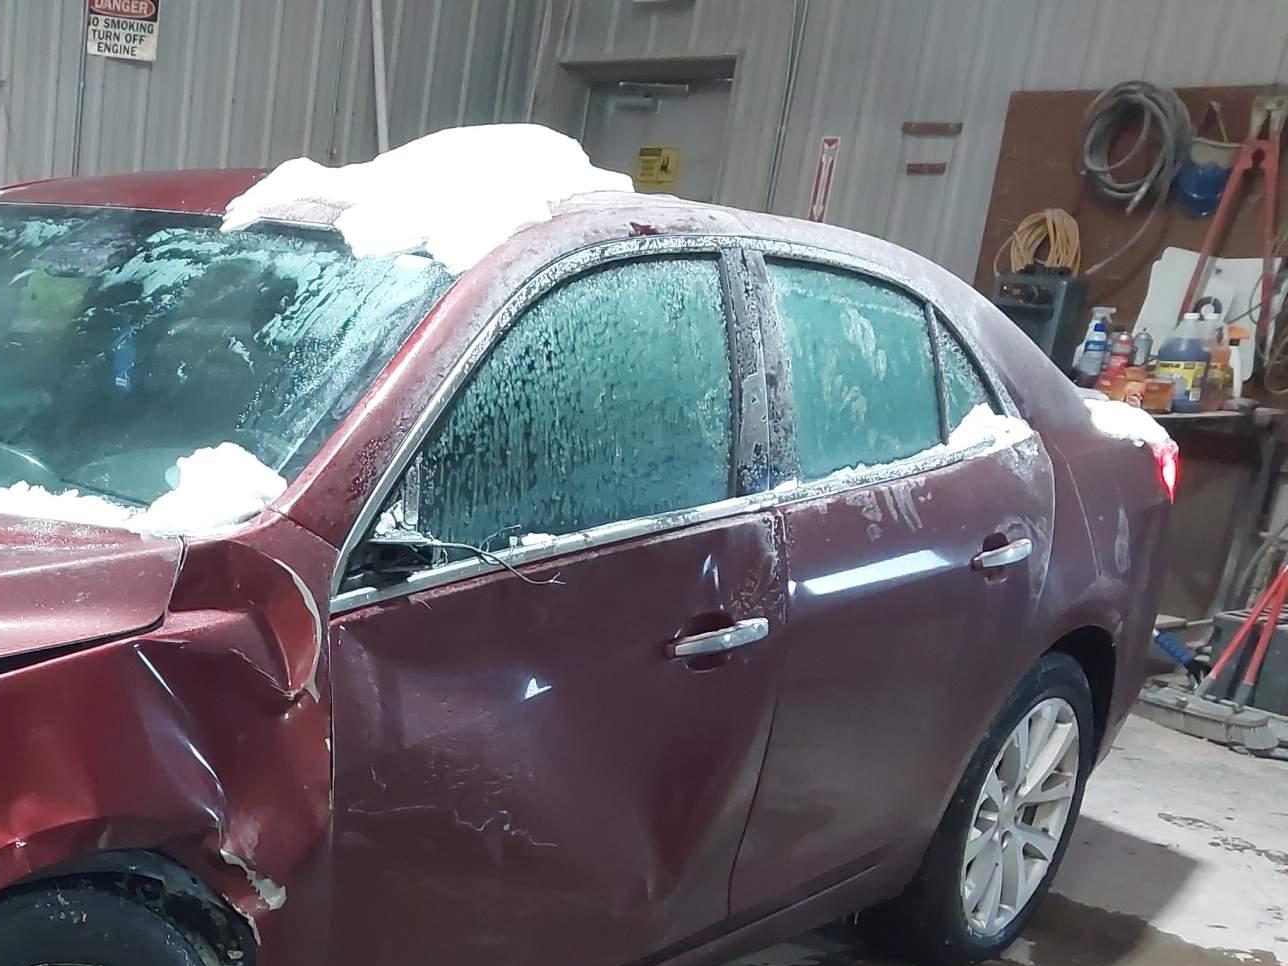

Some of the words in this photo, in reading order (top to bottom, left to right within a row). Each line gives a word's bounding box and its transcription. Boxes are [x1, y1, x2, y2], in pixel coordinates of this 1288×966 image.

[94, 0, 149, 15] DANGER
[103, 18, 154, 34] SMOKING
[92, 29, 120, 42] TURN
[125, 33, 146, 45] OFF
[97, 41, 137, 57] ENGINE
